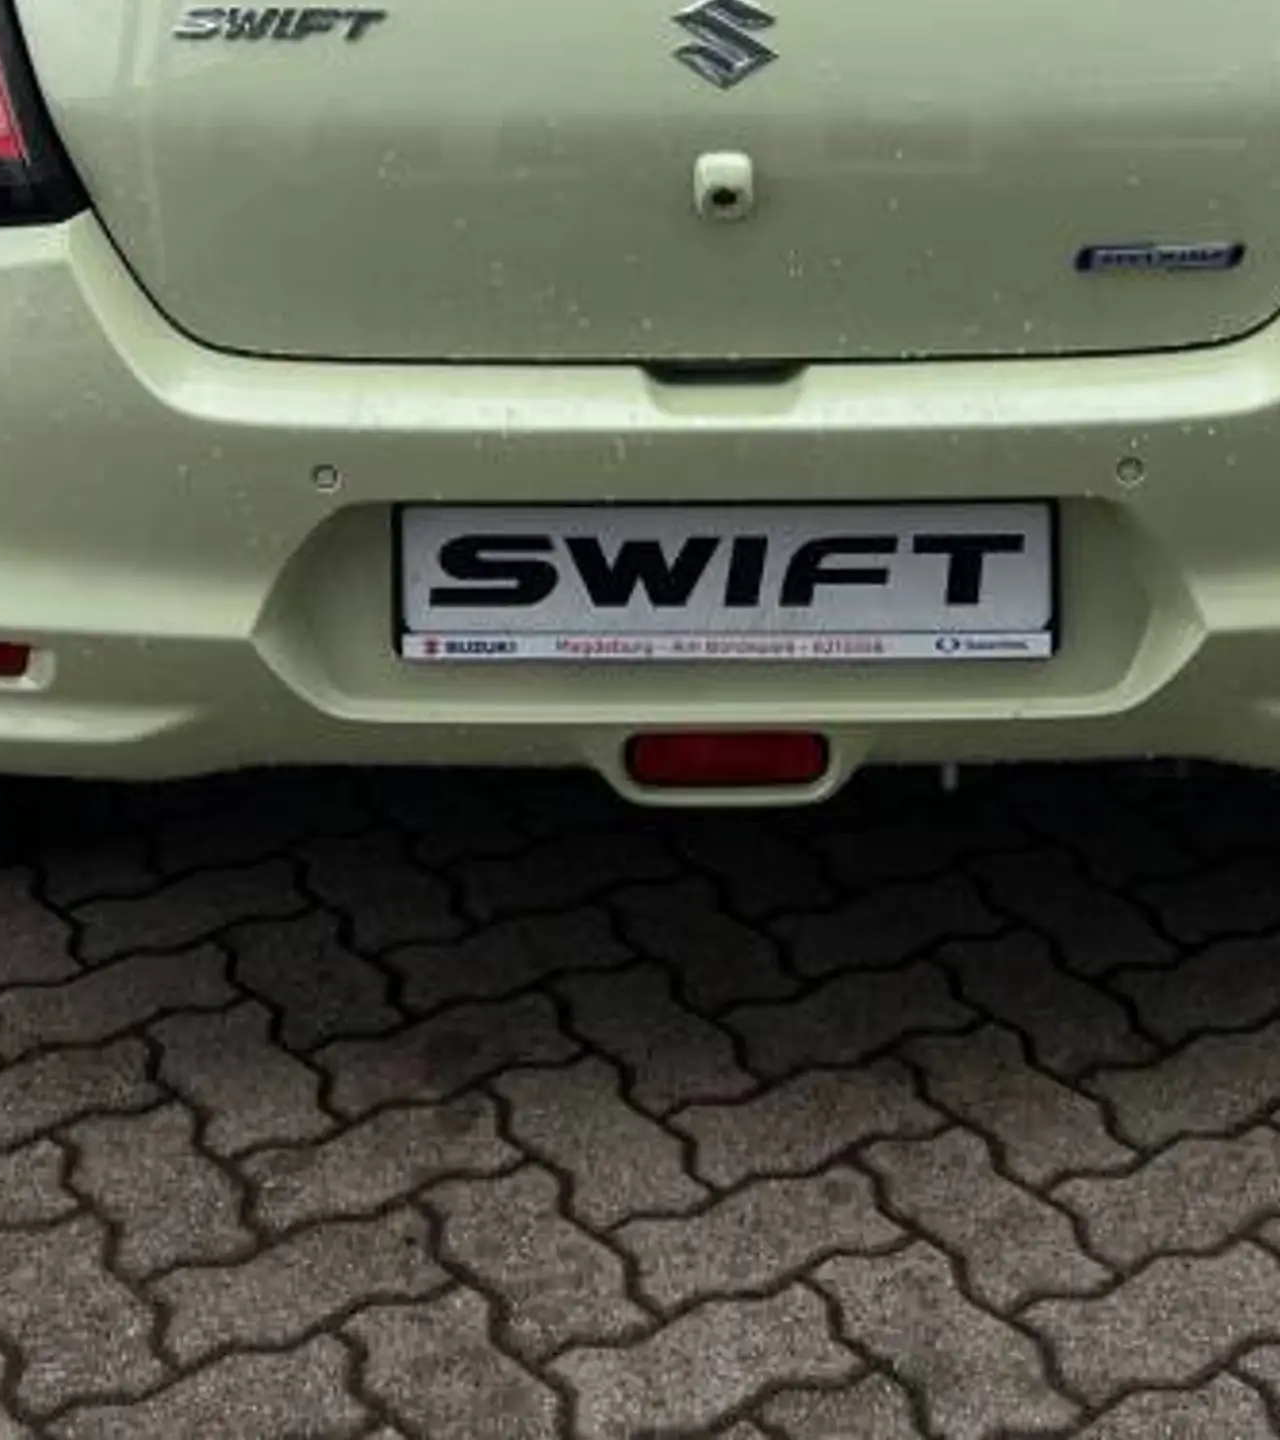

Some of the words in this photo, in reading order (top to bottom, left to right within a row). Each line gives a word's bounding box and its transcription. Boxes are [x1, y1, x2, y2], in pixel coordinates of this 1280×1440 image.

[172, 6, 388, 41] SWIFT
[428, 534, 1025, 607] SWIFT
[445, 639, 518, 655] SUZUKI
